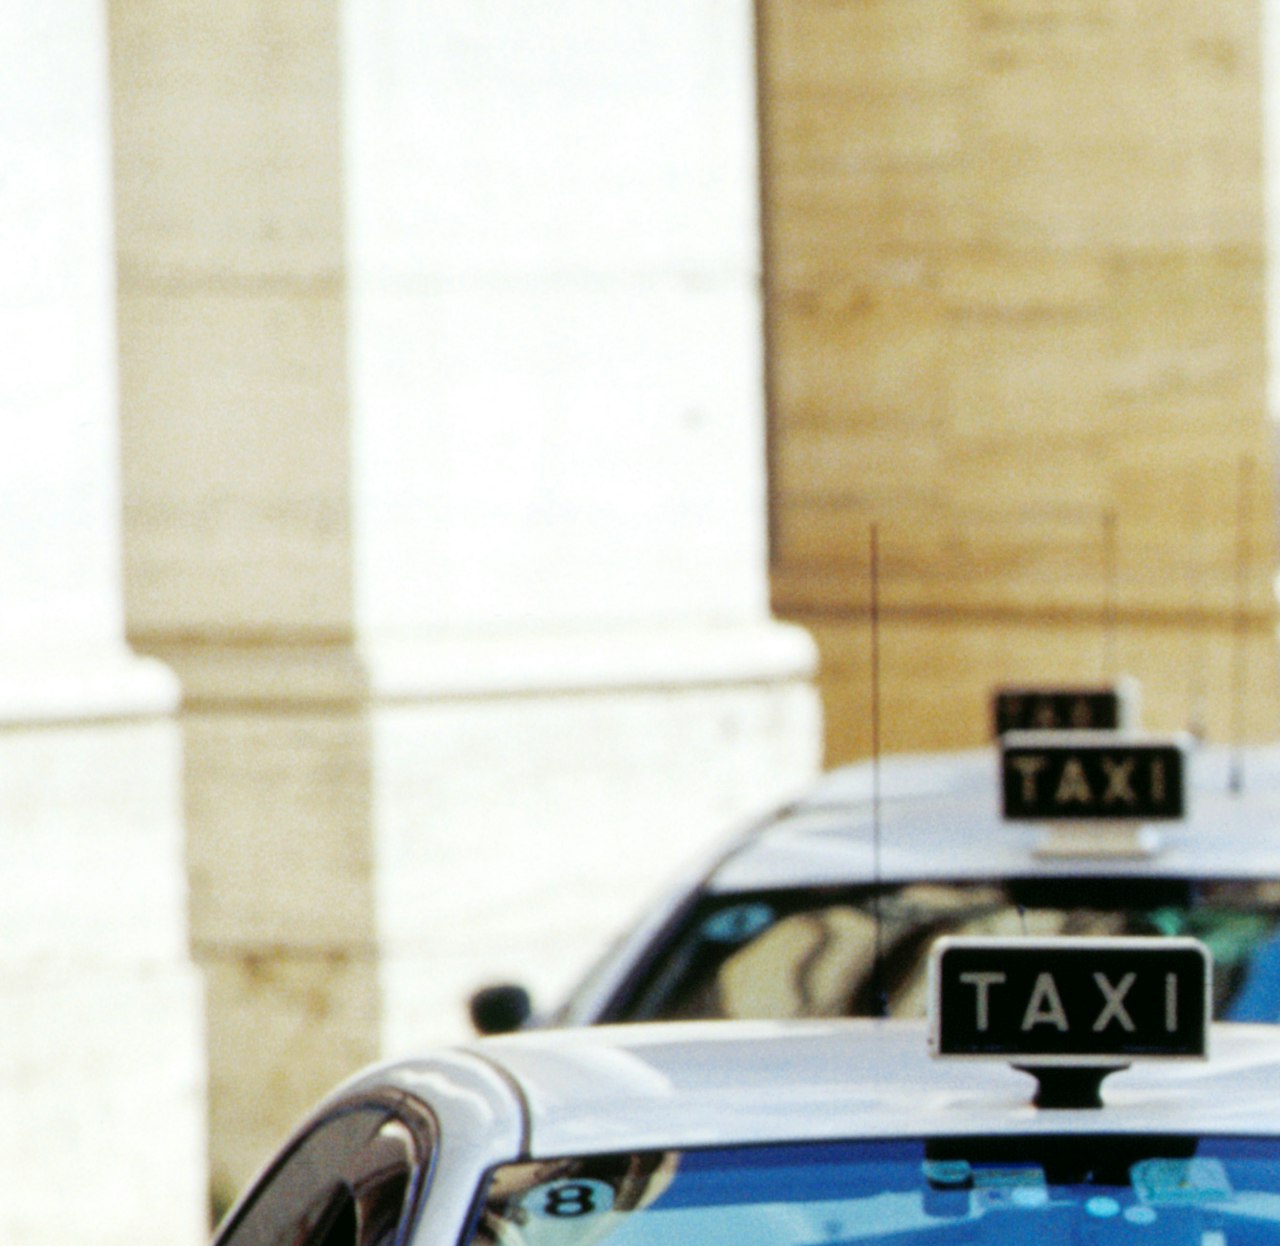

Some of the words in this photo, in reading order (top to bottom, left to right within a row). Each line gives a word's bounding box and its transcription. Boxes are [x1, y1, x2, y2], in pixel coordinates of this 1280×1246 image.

[1011, 756, 1166, 803] TAXI
[958, 971, 1179, 1033] TAXI
[544, 1184, 596, 1219] 8
